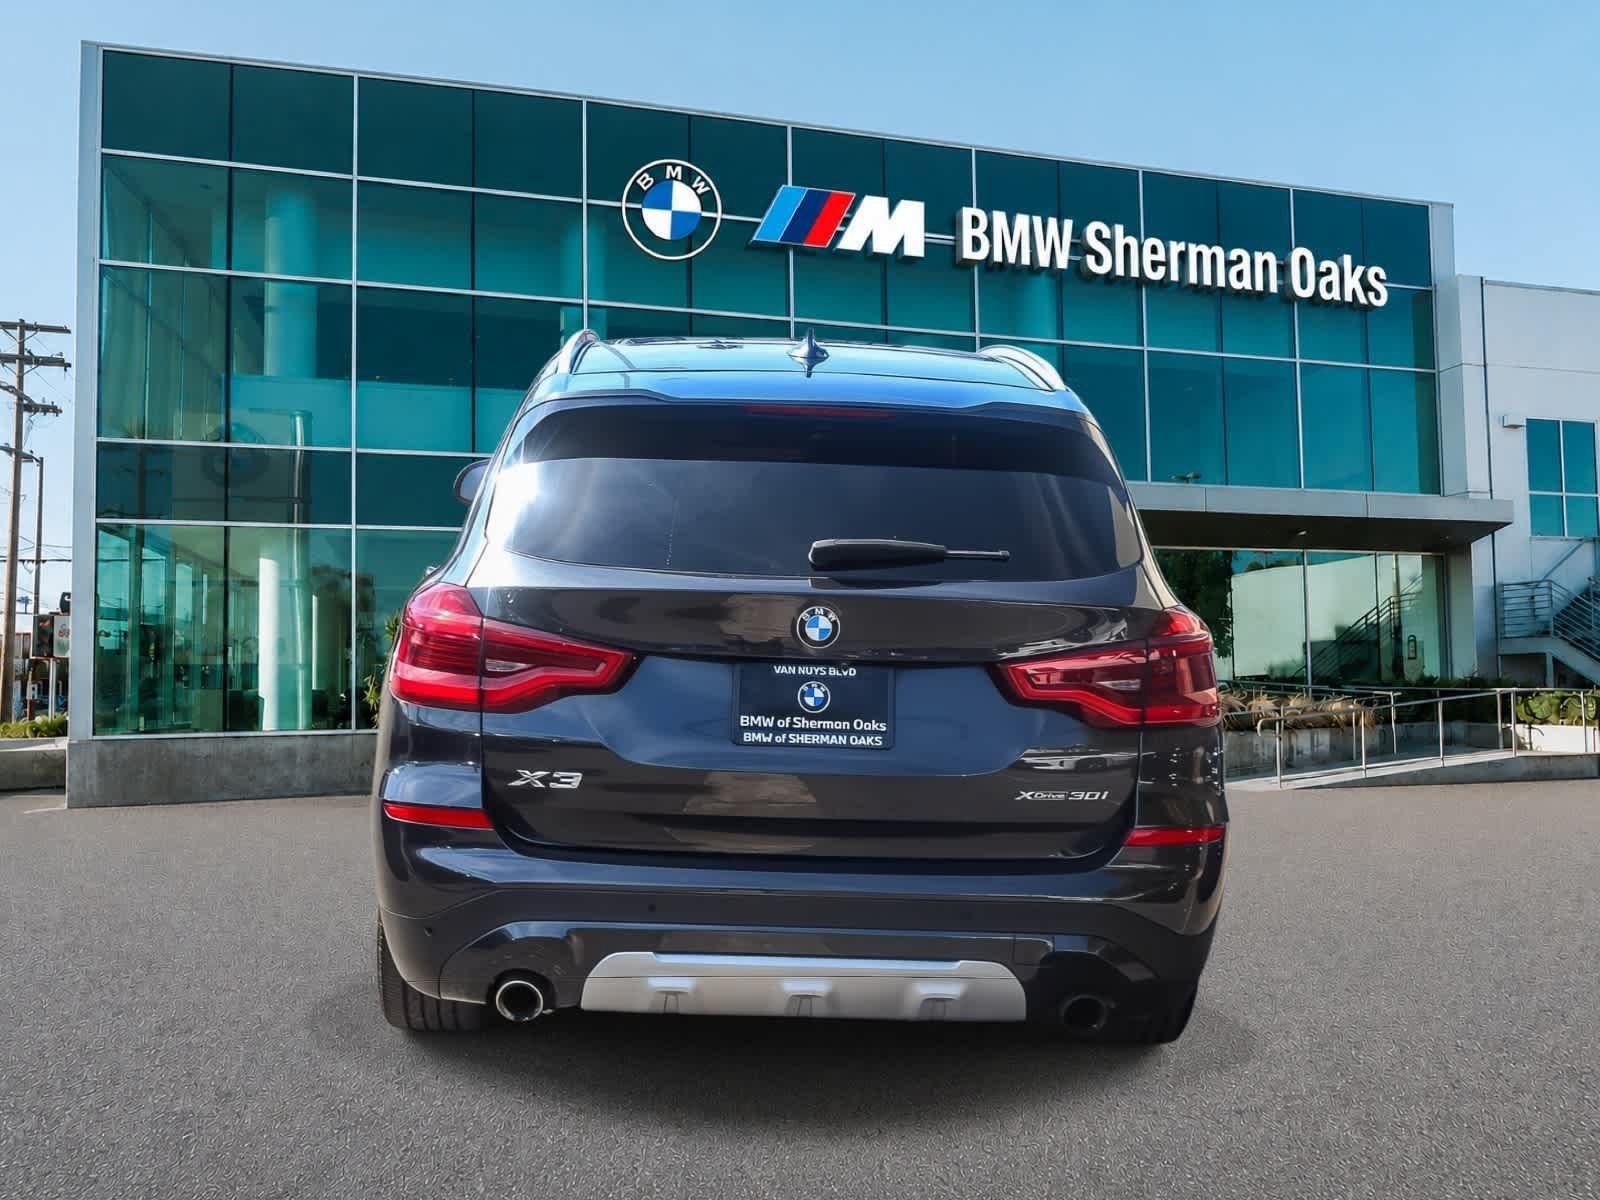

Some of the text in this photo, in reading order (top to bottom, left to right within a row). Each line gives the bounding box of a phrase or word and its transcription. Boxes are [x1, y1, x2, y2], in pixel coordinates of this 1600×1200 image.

[636, 164, 711, 195] BMW
[960, 206, 1389, 308] BMW Sherman Oaks
[802, 607, 837, 622] BMW
[774, 665, 857, 677] VAN NUYS BLVD
[740, 715, 887, 732] BMW of Sherman Oaks
[743, 732, 883, 746] BMW of SHERMAN OAKS
[507, 769, 583, 789] X3
